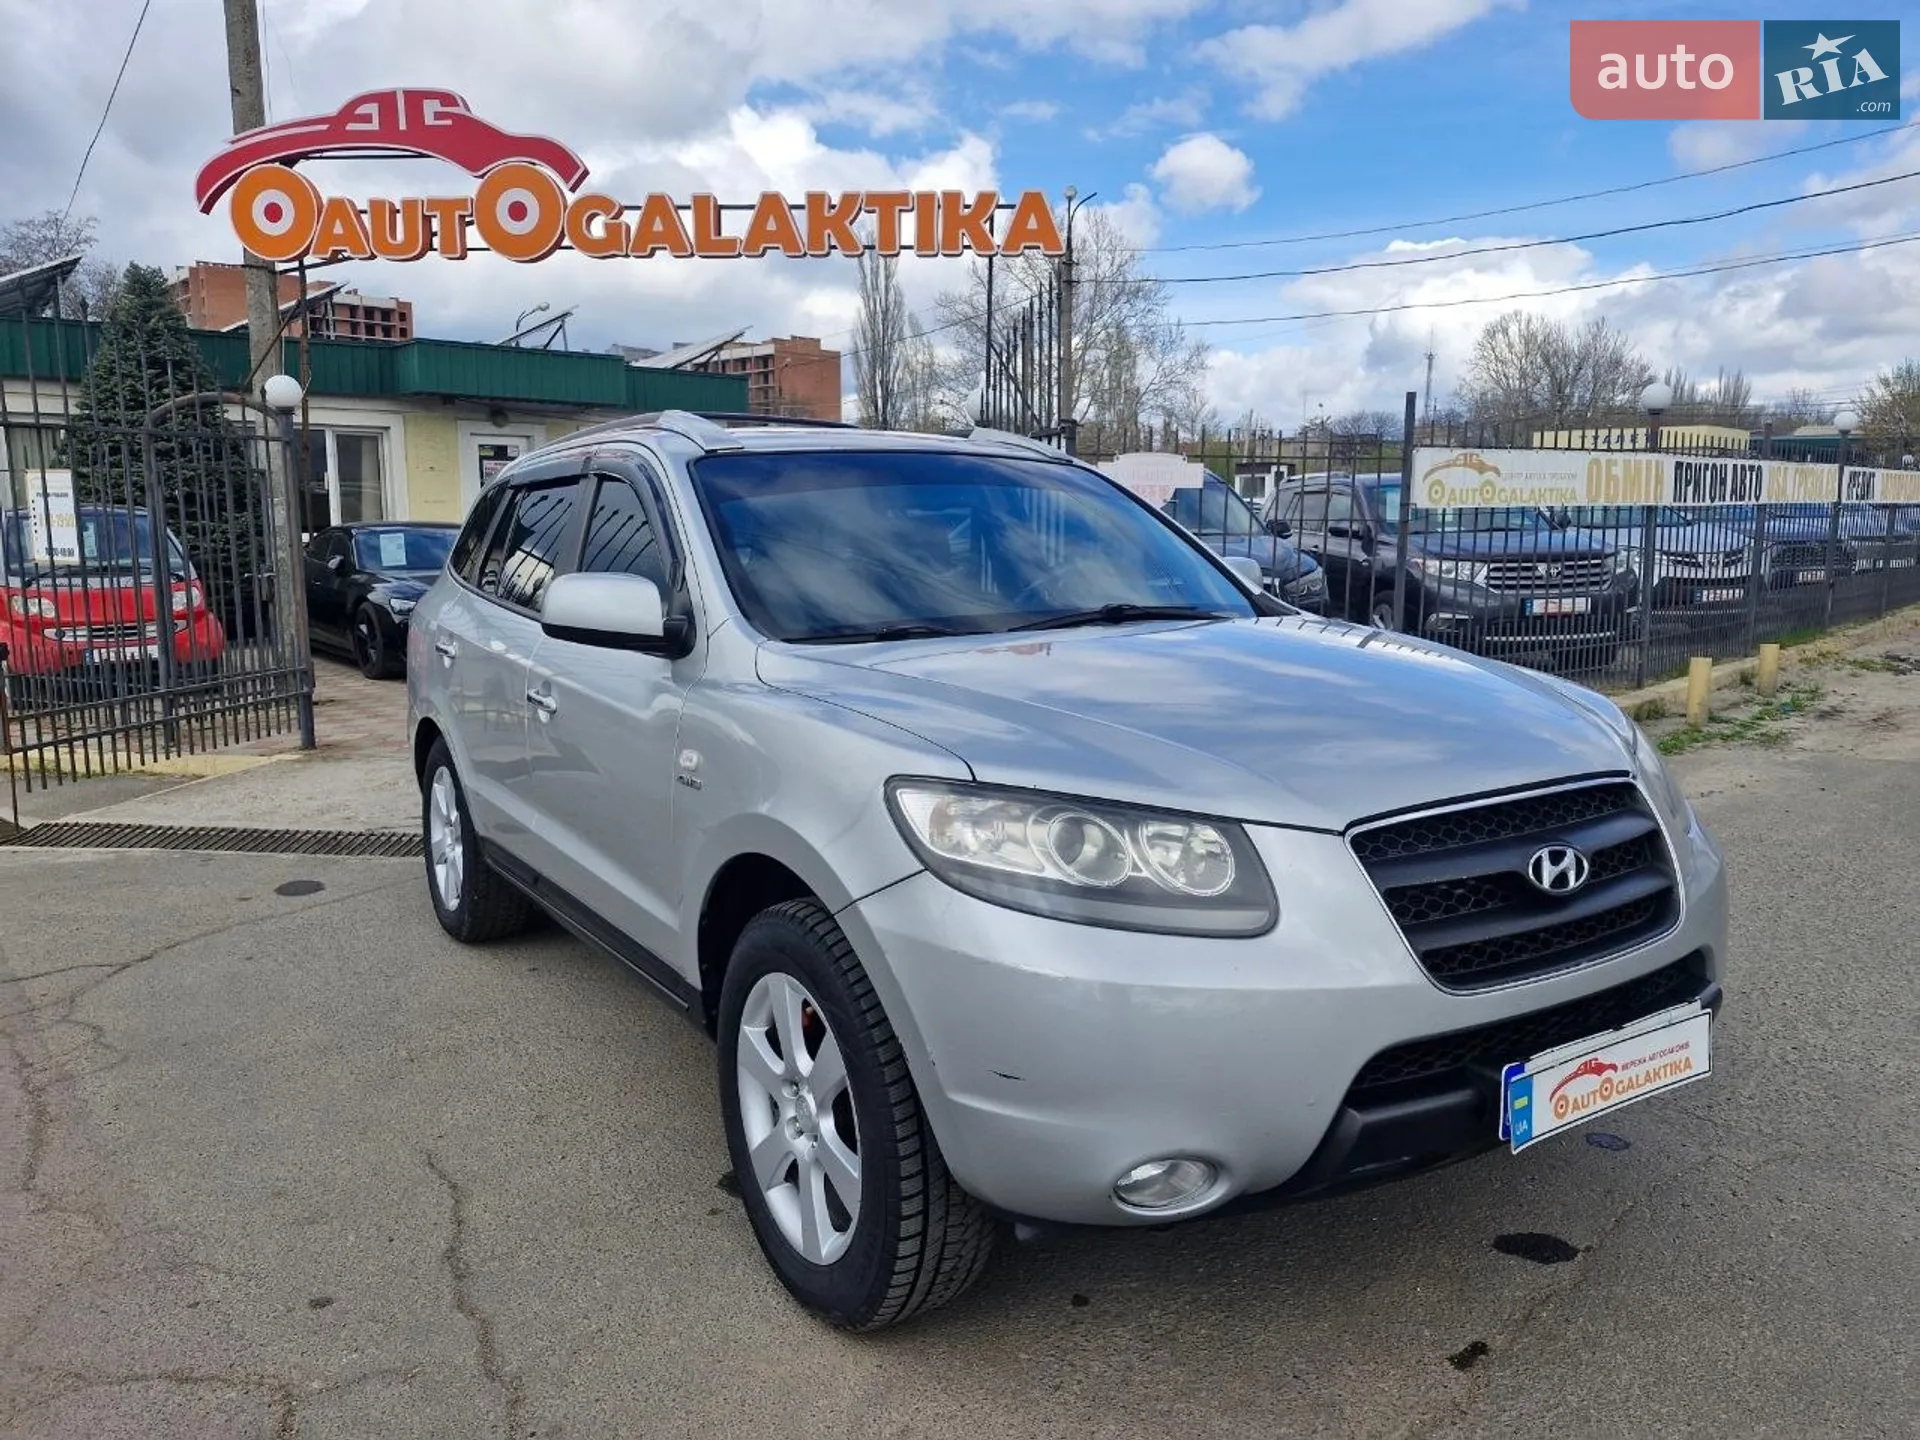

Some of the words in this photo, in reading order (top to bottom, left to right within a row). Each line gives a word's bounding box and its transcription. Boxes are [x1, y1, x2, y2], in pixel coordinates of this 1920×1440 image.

[1672, 460, 1728, 503] ПРИГОН
[1729, 463, 1763, 503] АВТО
[1514, 1118, 1529, 1136] UA
